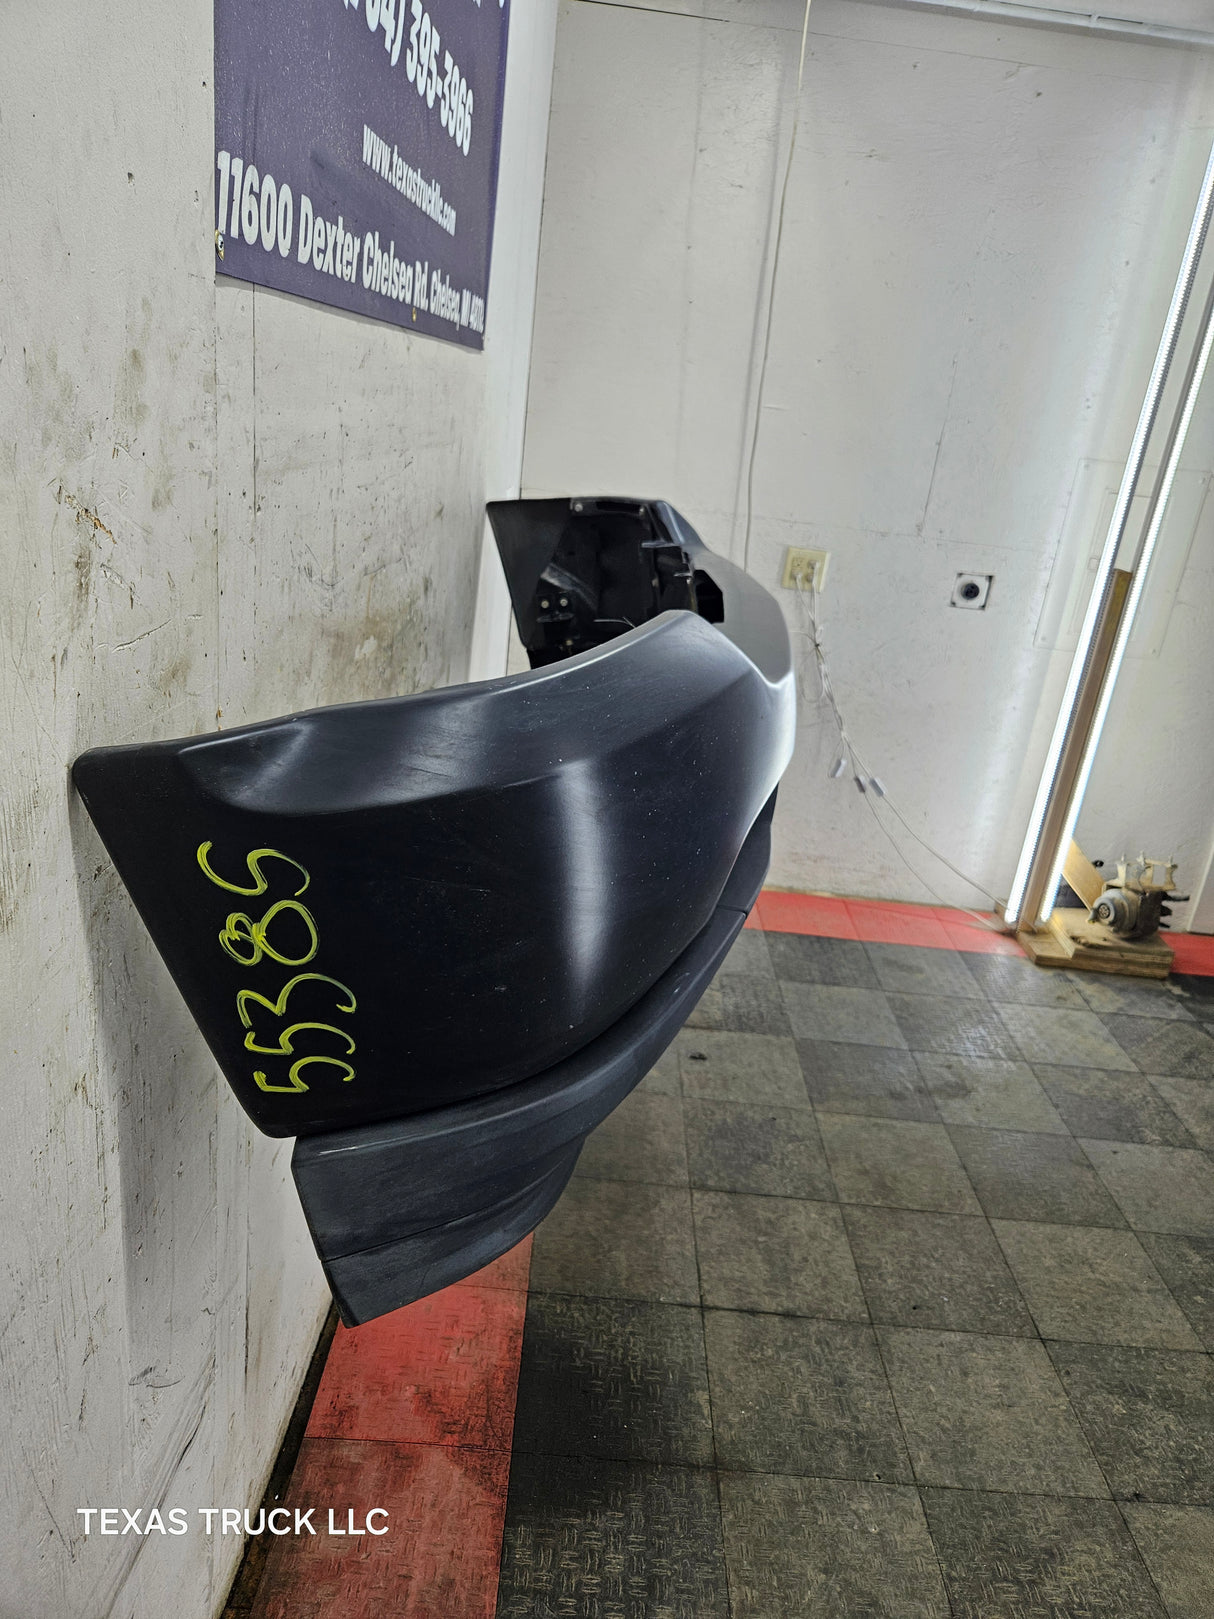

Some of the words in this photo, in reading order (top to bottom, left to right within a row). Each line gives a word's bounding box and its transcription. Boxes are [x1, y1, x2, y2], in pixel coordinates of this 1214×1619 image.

[406, 0, 473, 156] 395-3966
[217, 150, 293, 258] 11600
[297, 194, 361, 284] Dexter
[362, 231, 413, 306] Chelsea
[413, 260, 429, 312] Rd.
